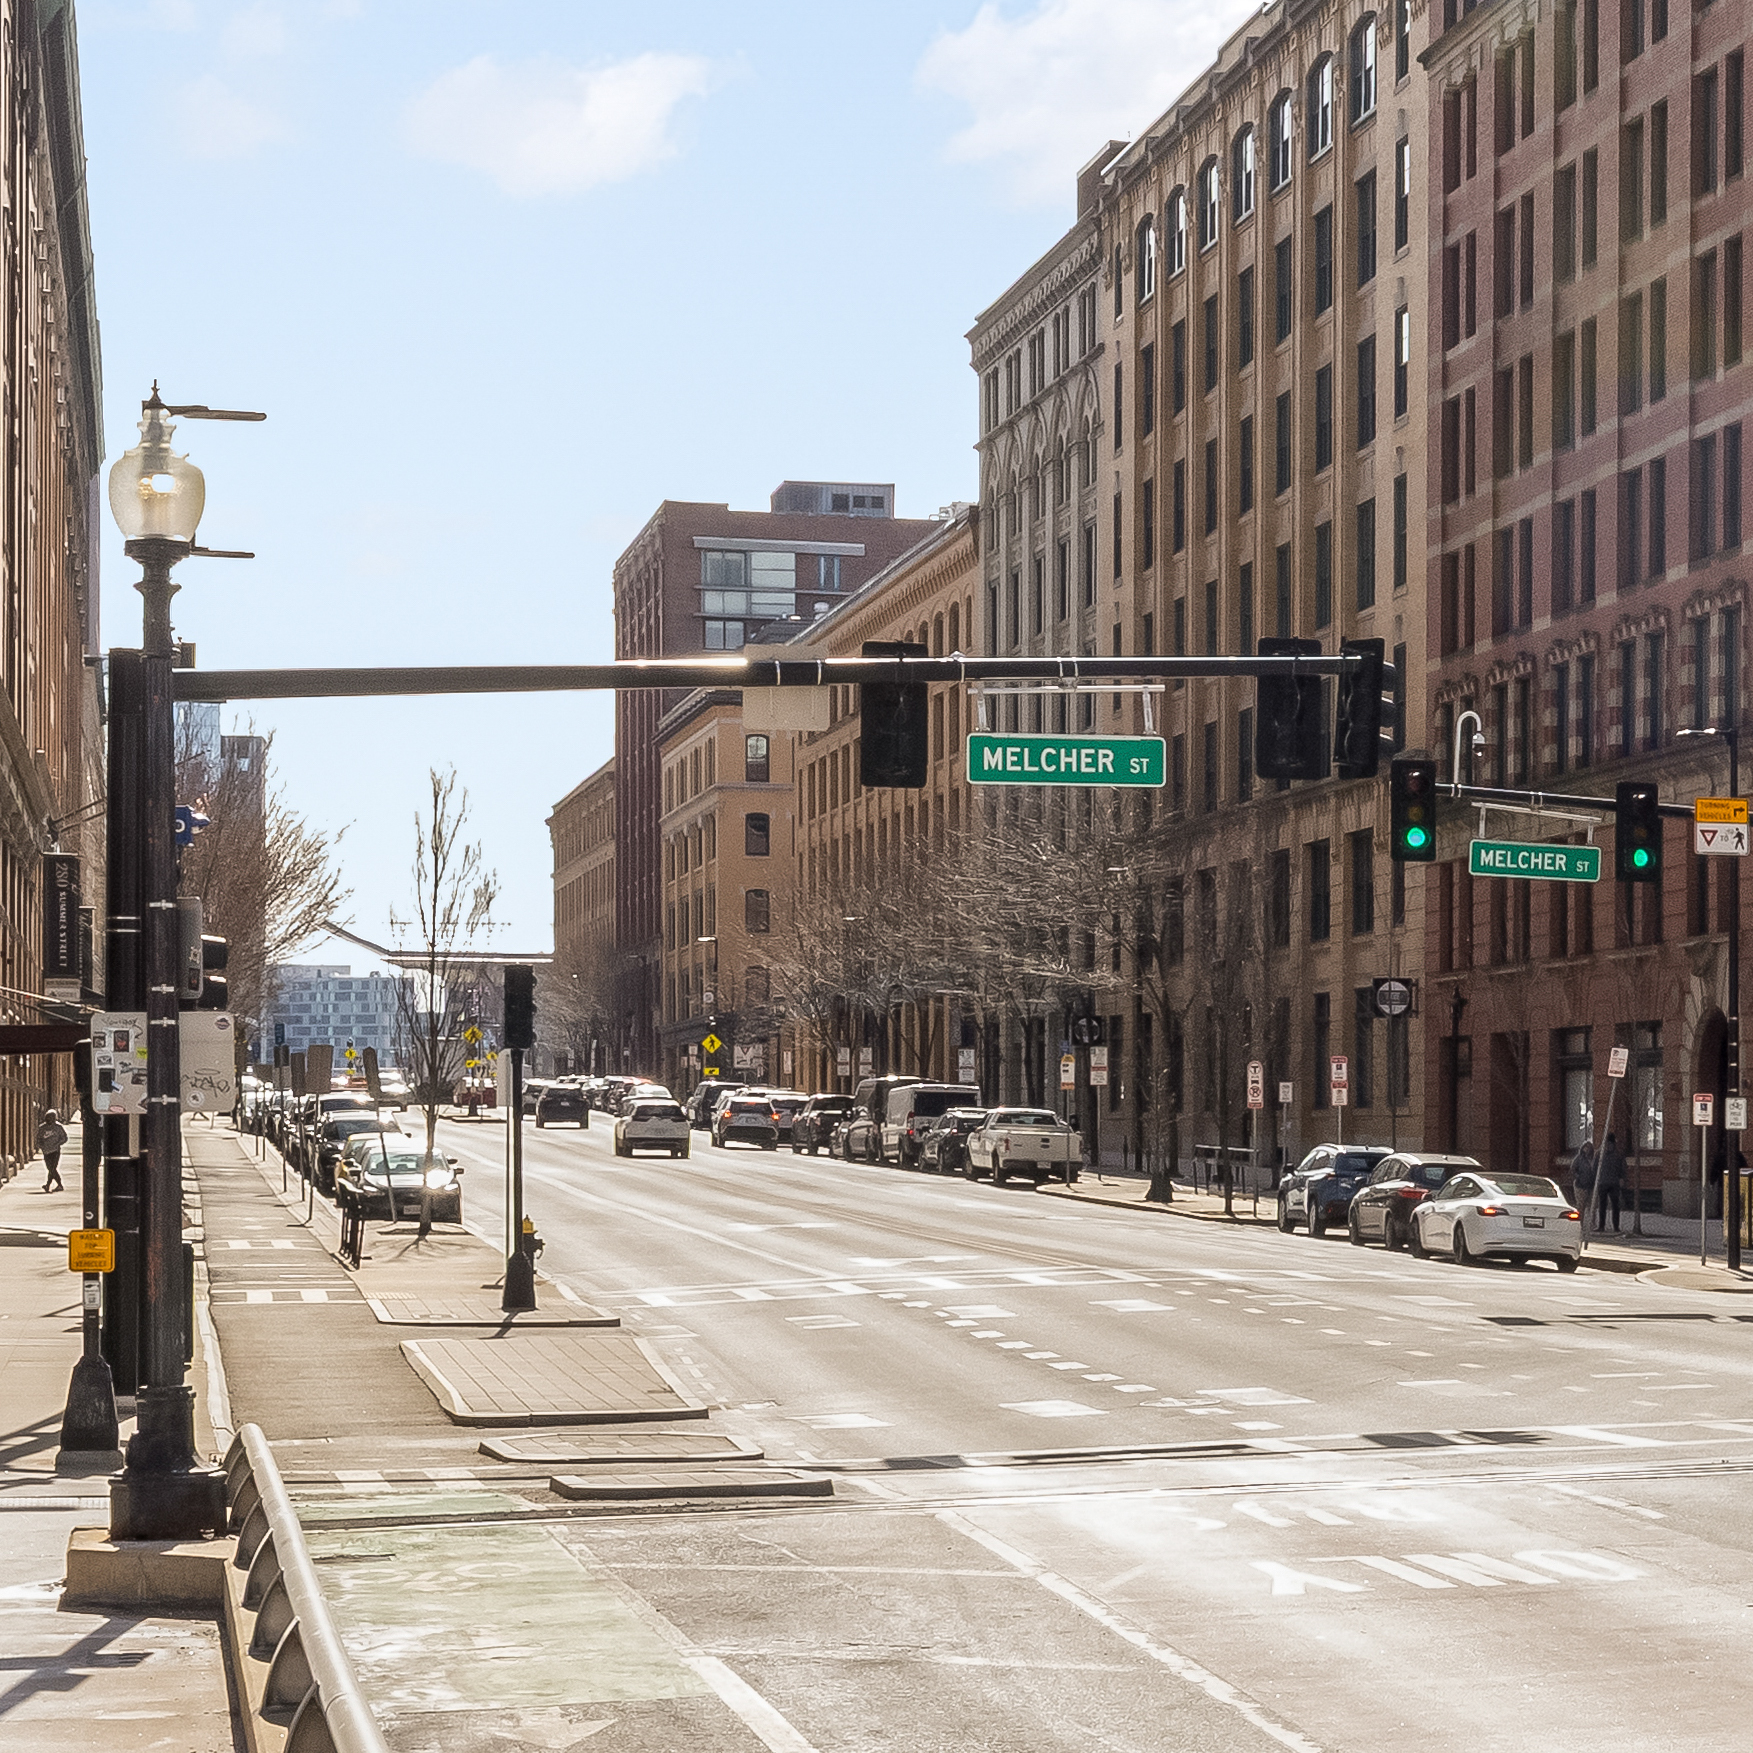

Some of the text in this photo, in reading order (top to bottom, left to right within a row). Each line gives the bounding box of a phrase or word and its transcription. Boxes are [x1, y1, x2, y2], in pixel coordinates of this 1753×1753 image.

[982, 746, 1150, 774] MELCHER ST
[1480, 848, 1590, 873] MELCHER ST
[1246, 1549, 1652, 1596] ONLY
